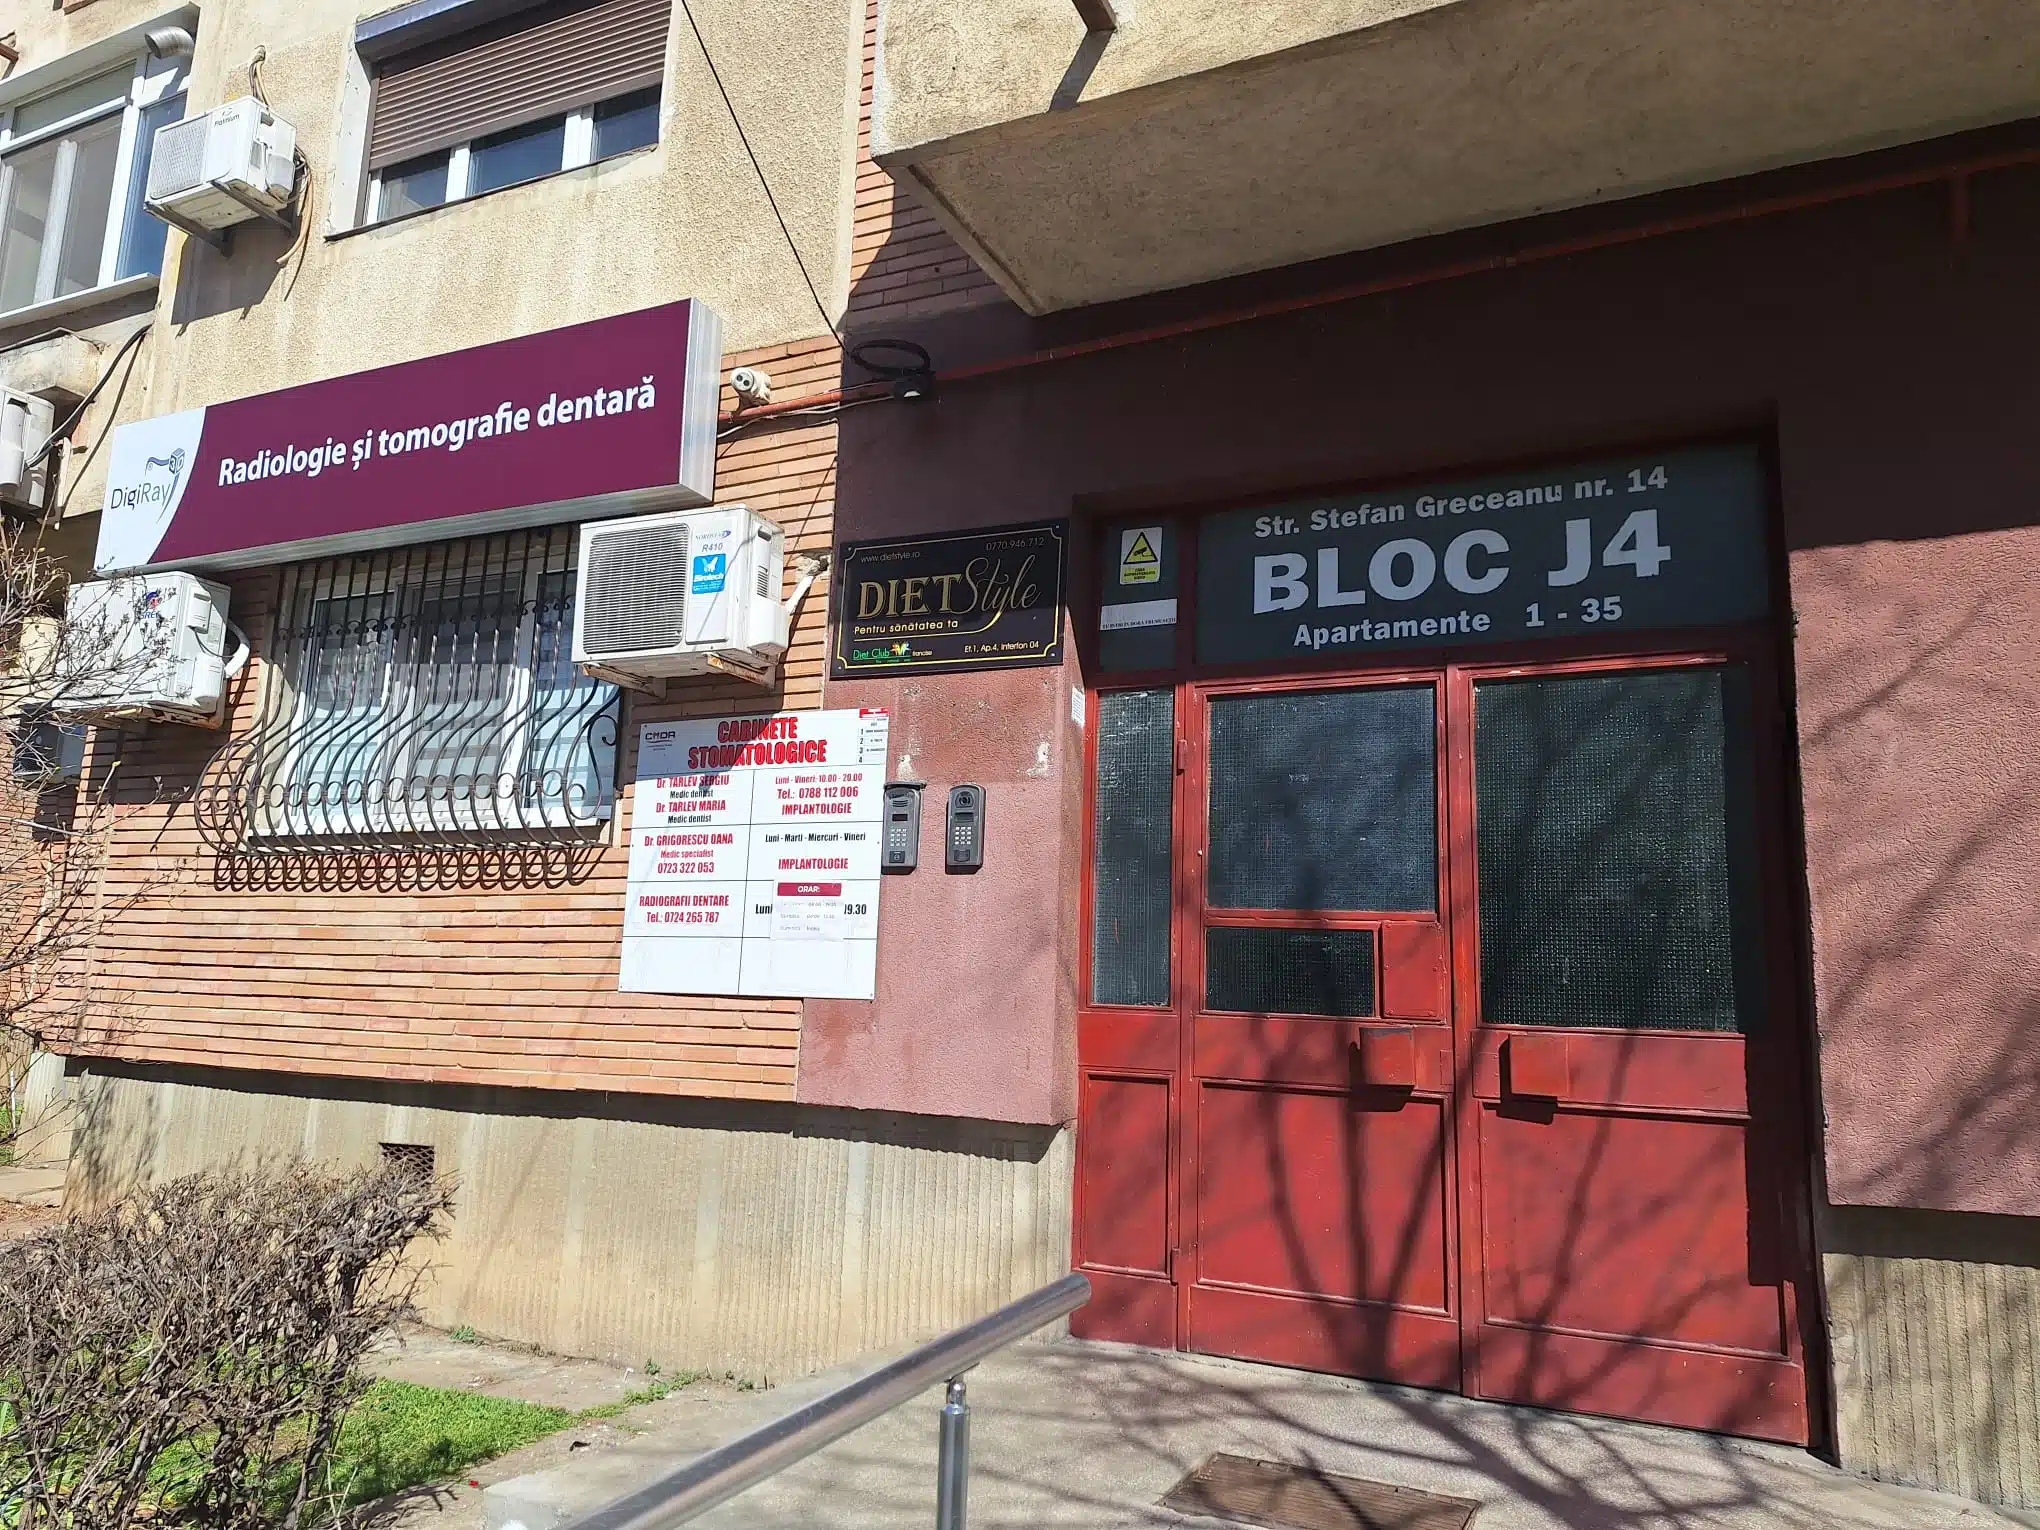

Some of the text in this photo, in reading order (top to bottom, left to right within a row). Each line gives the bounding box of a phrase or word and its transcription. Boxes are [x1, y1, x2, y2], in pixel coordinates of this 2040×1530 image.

[218, 375, 656, 487] Radiologie și tomografie dentară
[110, 482, 171, 510] DigiRay
[1254, 466, 1668, 538] Str. Stefan Greceanu nr. 14
[702, 542, 724, 553] R410
[986, 536, 1045, 551] 0770.946.712
[861, 551, 921, 563] www.dietstyle.ro
[1253, 509, 1671, 614] BLOC J4
[858, 554, 1042, 619] DIET Style
[854, 625, 886, 635] Pentru
[947, 619, 959, 629] ta
[1293, 610, 1491, 650] Apartamente
[1526, 602, 1545, 628] 1
[1581, 596, 1623, 623] 35
[1029, 640, 1039, 648] 04
[853, 644, 890, 660] Diet Club
[717, 716, 799, 743] CABINETE
[688, 740, 828, 769] STOMATOLOGICE
[669, 775, 698, 788] TARLEV
[775, 776, 790, 784] Luni
[819, 773, 838, 782] 10.00
[843, 771, 863, 782] 20.00
[670, 789, 714, 799] Medic dentist
[799, 787, 821, 798] 0788
[824, 786, 838, 798] 112
[840, 786, 859, 797] 006
[668, 801, 698, 813] TARLEV
[699, 800, 726, 811] MARIA
[782, 802, 852, 815] IMPLANTOLOGIE
[668, 814, 712, 824] Medic dentist
[657, 834, 709, 846] GRIGORESCU
[711, 833, 733, 844] OANA
[765, 833, 780, 842] Luni
[785, 833, 803, 842] Marti
[808, 832, 838, 842] Miercuri
[844, 832, 866, 841] Vineri
[661, 849, 713, 859] Medic specialist
[658, 861, 715, 874] 0723 322 053
[778, 857, 849, 870] IMPLANTOLOGIE
[640, 895, 729, 907] RADIOGRAFII DENTARE
[665, 911, 685, 923] 0724
[686, 911, 703, 923] 265
[705, 911, 720, 922] 787
